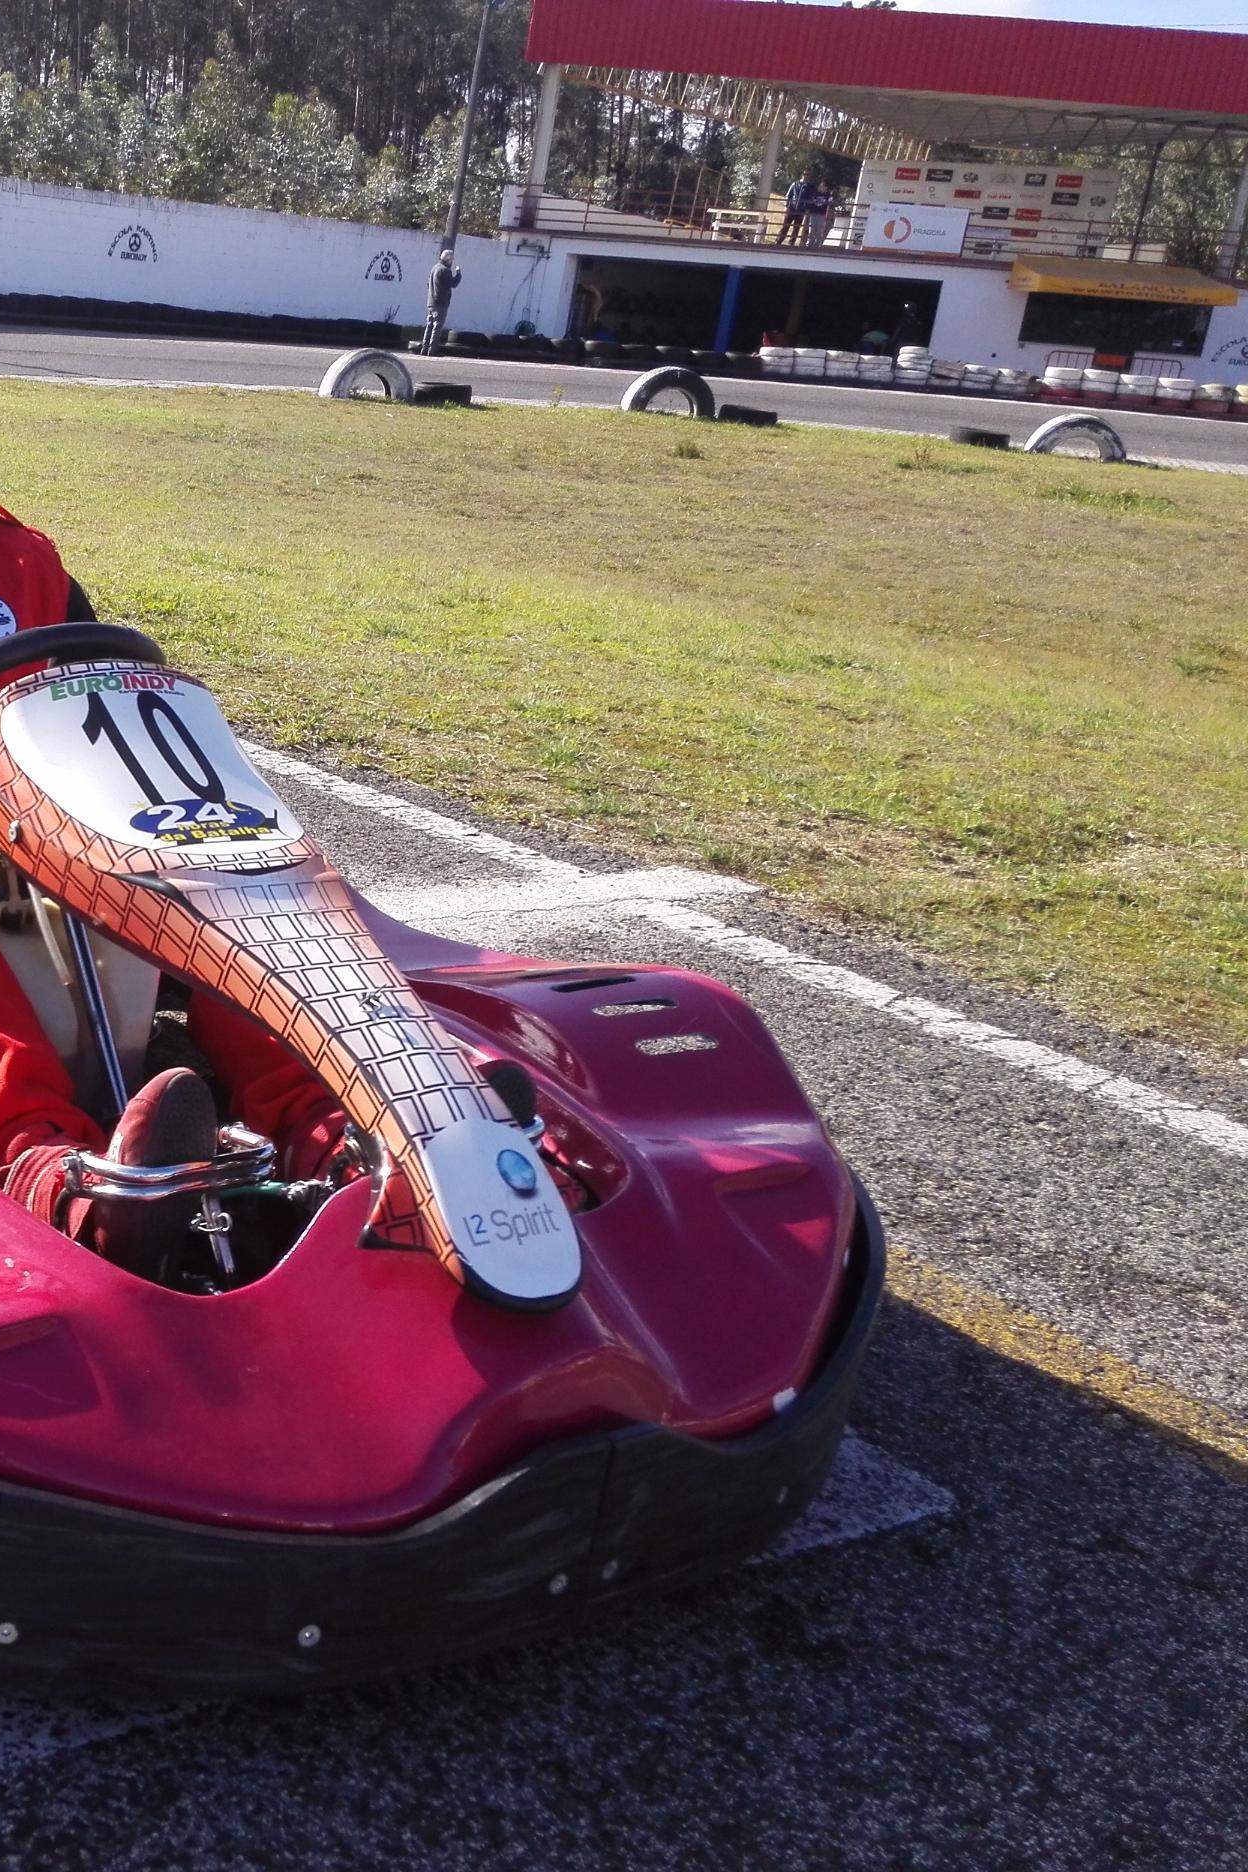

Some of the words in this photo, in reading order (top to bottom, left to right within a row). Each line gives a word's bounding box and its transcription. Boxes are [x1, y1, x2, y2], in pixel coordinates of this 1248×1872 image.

[51, 674, 177, 701] EUROINDY
[81, 690, 226, 804] 10
[146, 801, 238, 831] 24
[175, 821, 230, 832] horas
[159, 833, 187, 843] da
[191, 826, 271, 840] Batalha
[490, 1202, 561, 1246] Spirit
